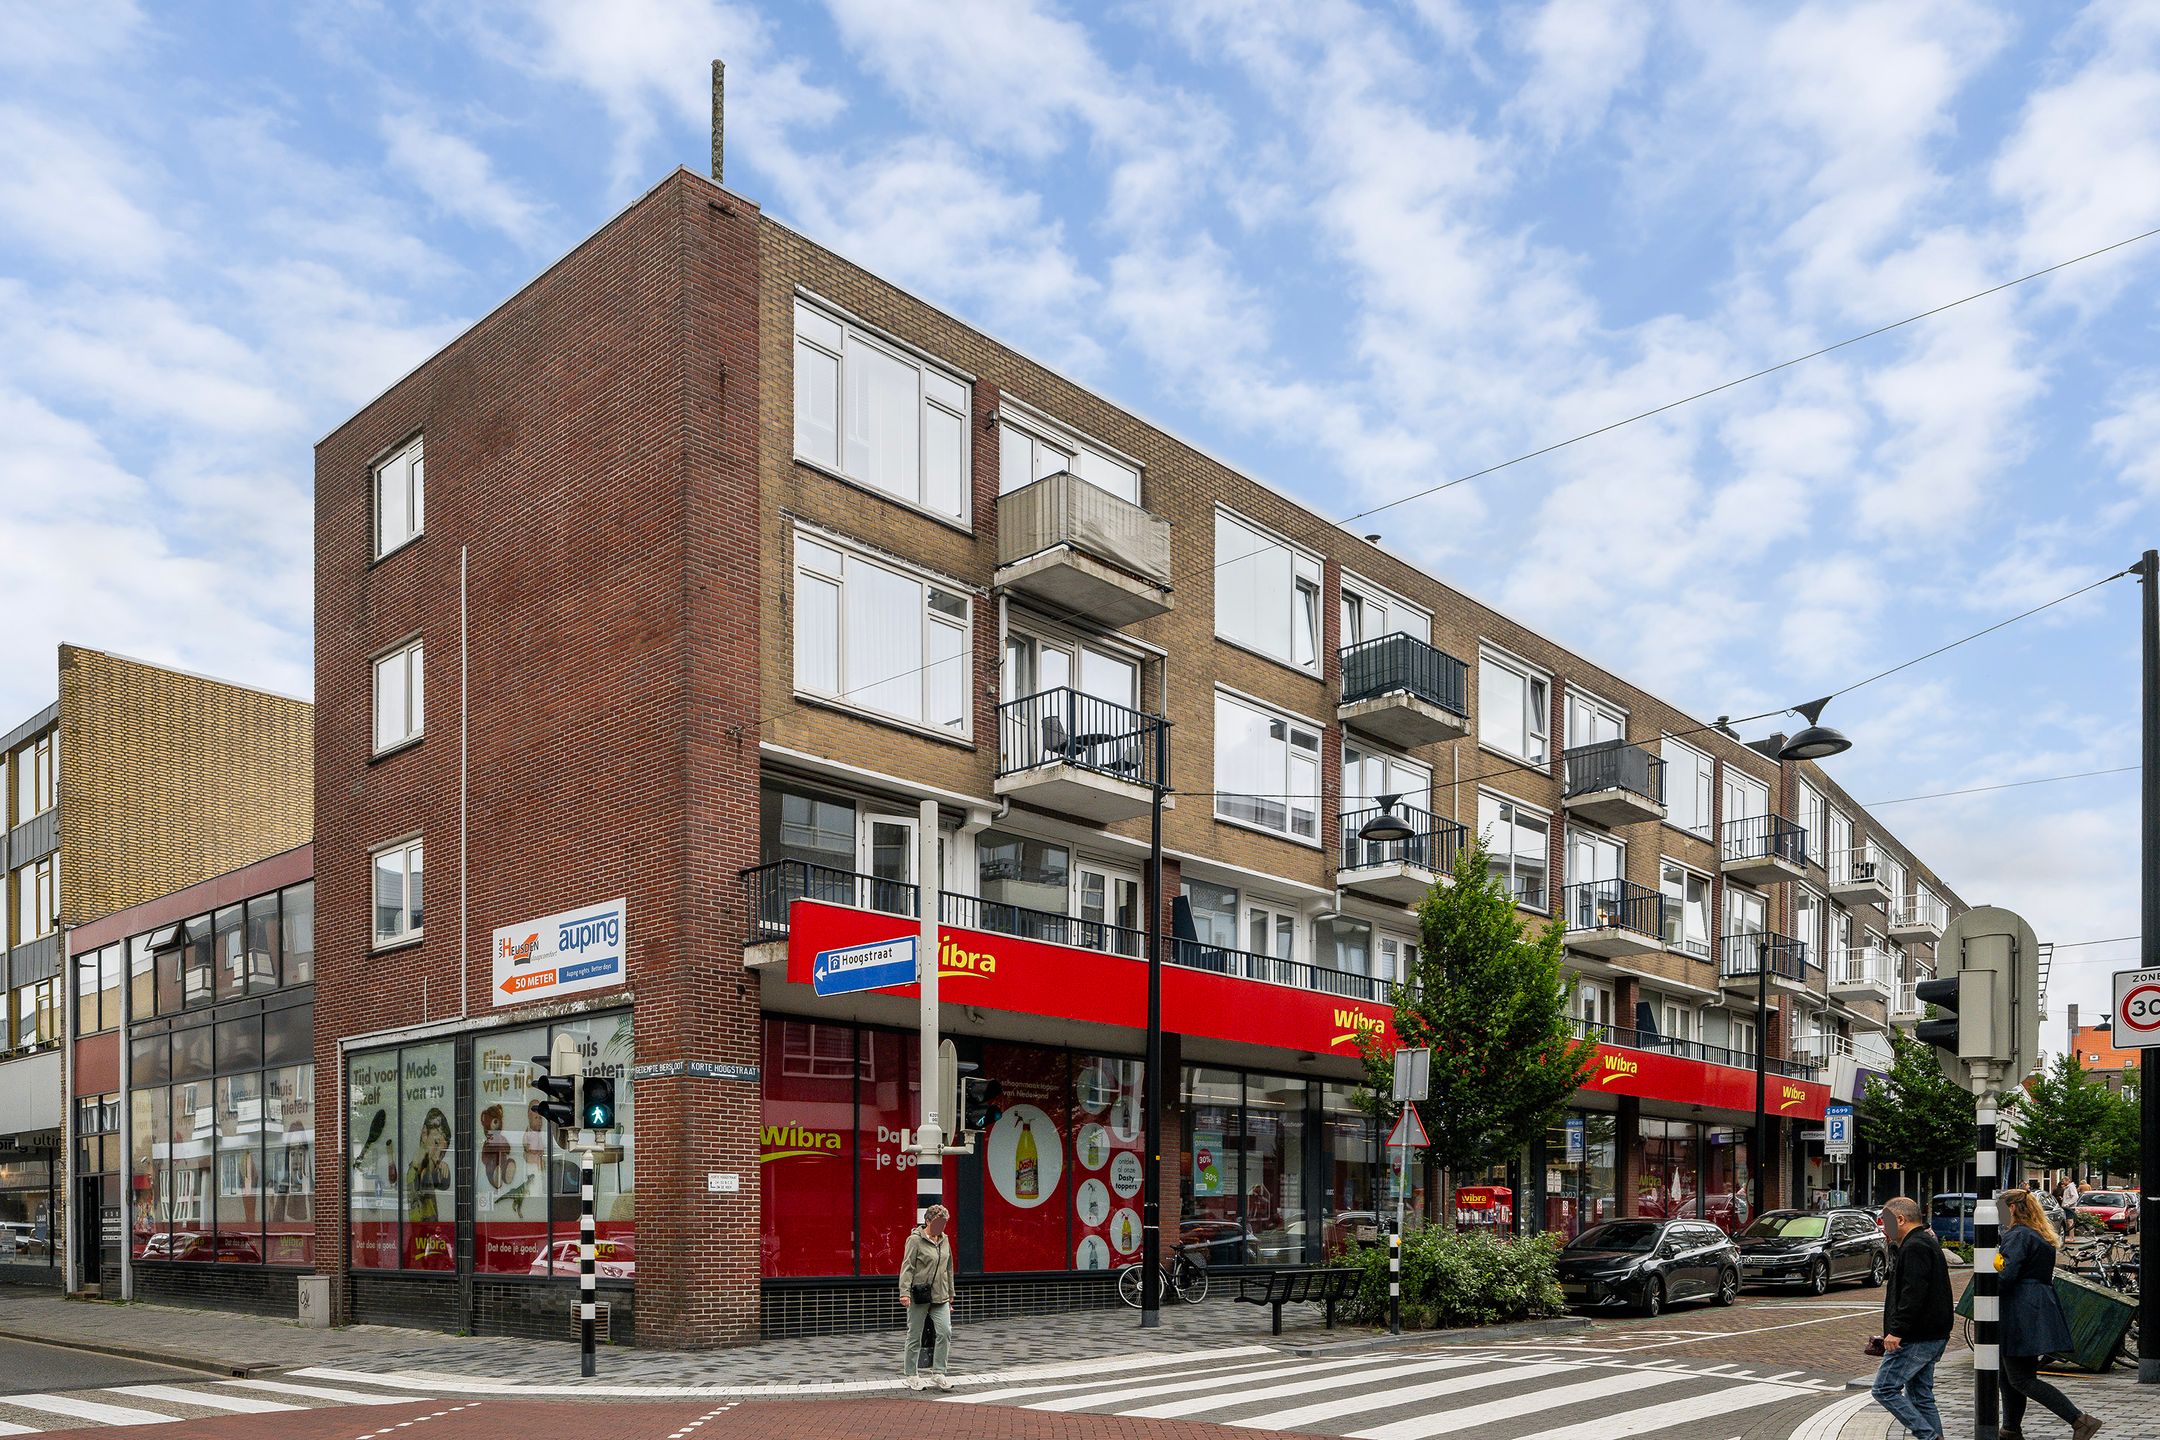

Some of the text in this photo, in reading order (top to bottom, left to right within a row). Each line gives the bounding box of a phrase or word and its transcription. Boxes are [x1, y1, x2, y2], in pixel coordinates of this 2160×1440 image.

[559, 918, 619, 953] auping
[842, 947, 893, 966] Hoogstraat
[939, 935, 996, 973] ibra
[515, 973, 554, 989] 50 METER
[1334, 1006, 1385, 1034] Wibra
[577, 1036, 598, 1058] uis
[483, 1049, 512, 1072] Fijne
[1604, 1053, 1638, 1074] Wibra
[353, 1066, 399, 1087] Tijd voor
[406, 1058, 437, 1080] Mode
[635, 1064, 659, 1074] GEDEMPTE
[691, 1062, 757, 1076] KORTE HOOGSTRAAT
[270, 1080, 293, 1098] Thuis
[483, 1067, 534, 1097] vrije tijd
[406, 1085, 444, 1101] van nu
[1782, 1084, 1806, 1100] Wibra
[760, 1120, 841, 1149] Wibra
[878, 1126, 900, 1143] Da
[876, 1148, 918, 1171] je go
[1118, 1157, 1135, 1165] ontdek
[1199, 1155, 1212, 1164] 30%
[1877, 1162, 1902, 1170] OPE
[1118, 1174, 1136, 1184] Dasty
[1205, 1172, 1218, 1183] 50%
[1115, 1183, 1138, 1191] toppers
[356, 1240, 365, 1249] Dat
[366, 1240, 375, 1249] doe
[415, 1233, 446, 1249] Wibra
[487, 1242, 539, 1256] Dat doe je goed.
